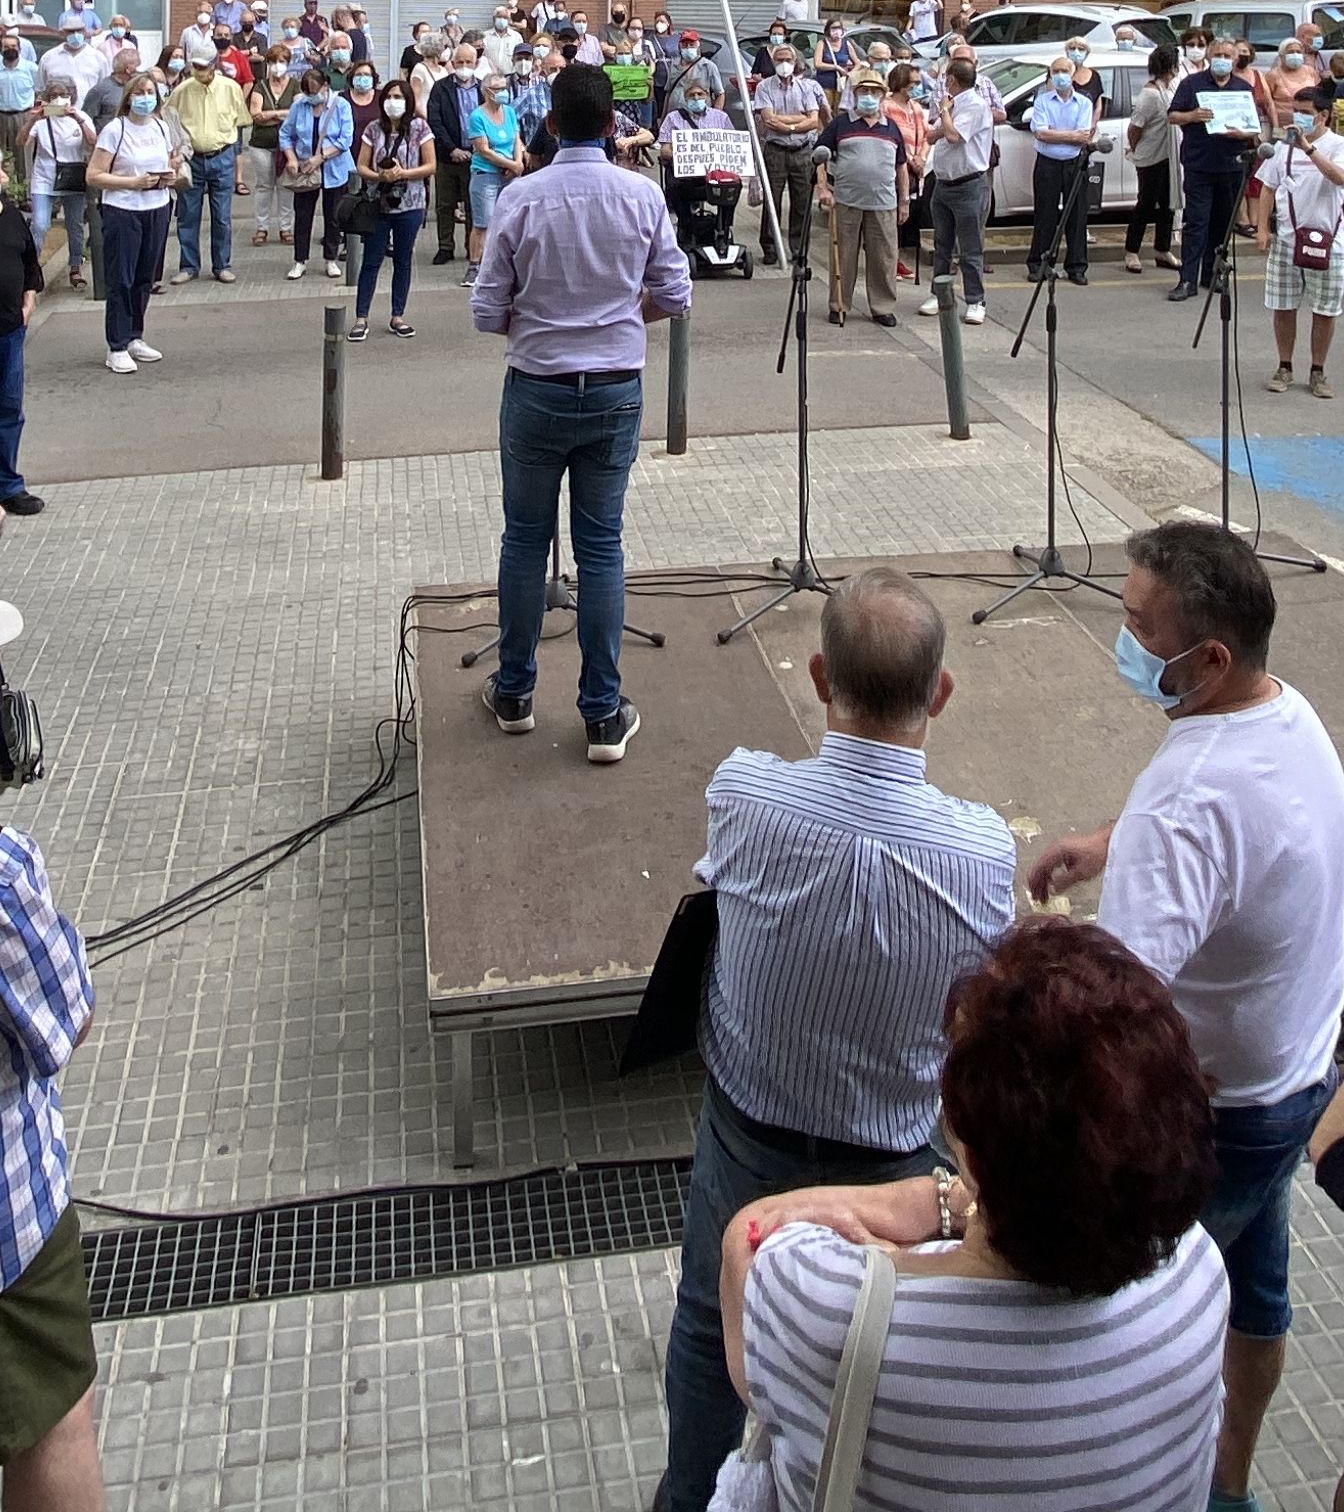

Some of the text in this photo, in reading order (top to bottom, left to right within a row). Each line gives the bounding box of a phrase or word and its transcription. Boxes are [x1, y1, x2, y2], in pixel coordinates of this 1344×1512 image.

[676, 132, 688, 142] EL
[677, 144, 687, 152] ES
[691, 143, 705, 152] DEL
[678, 164, 695, 176] LOS
